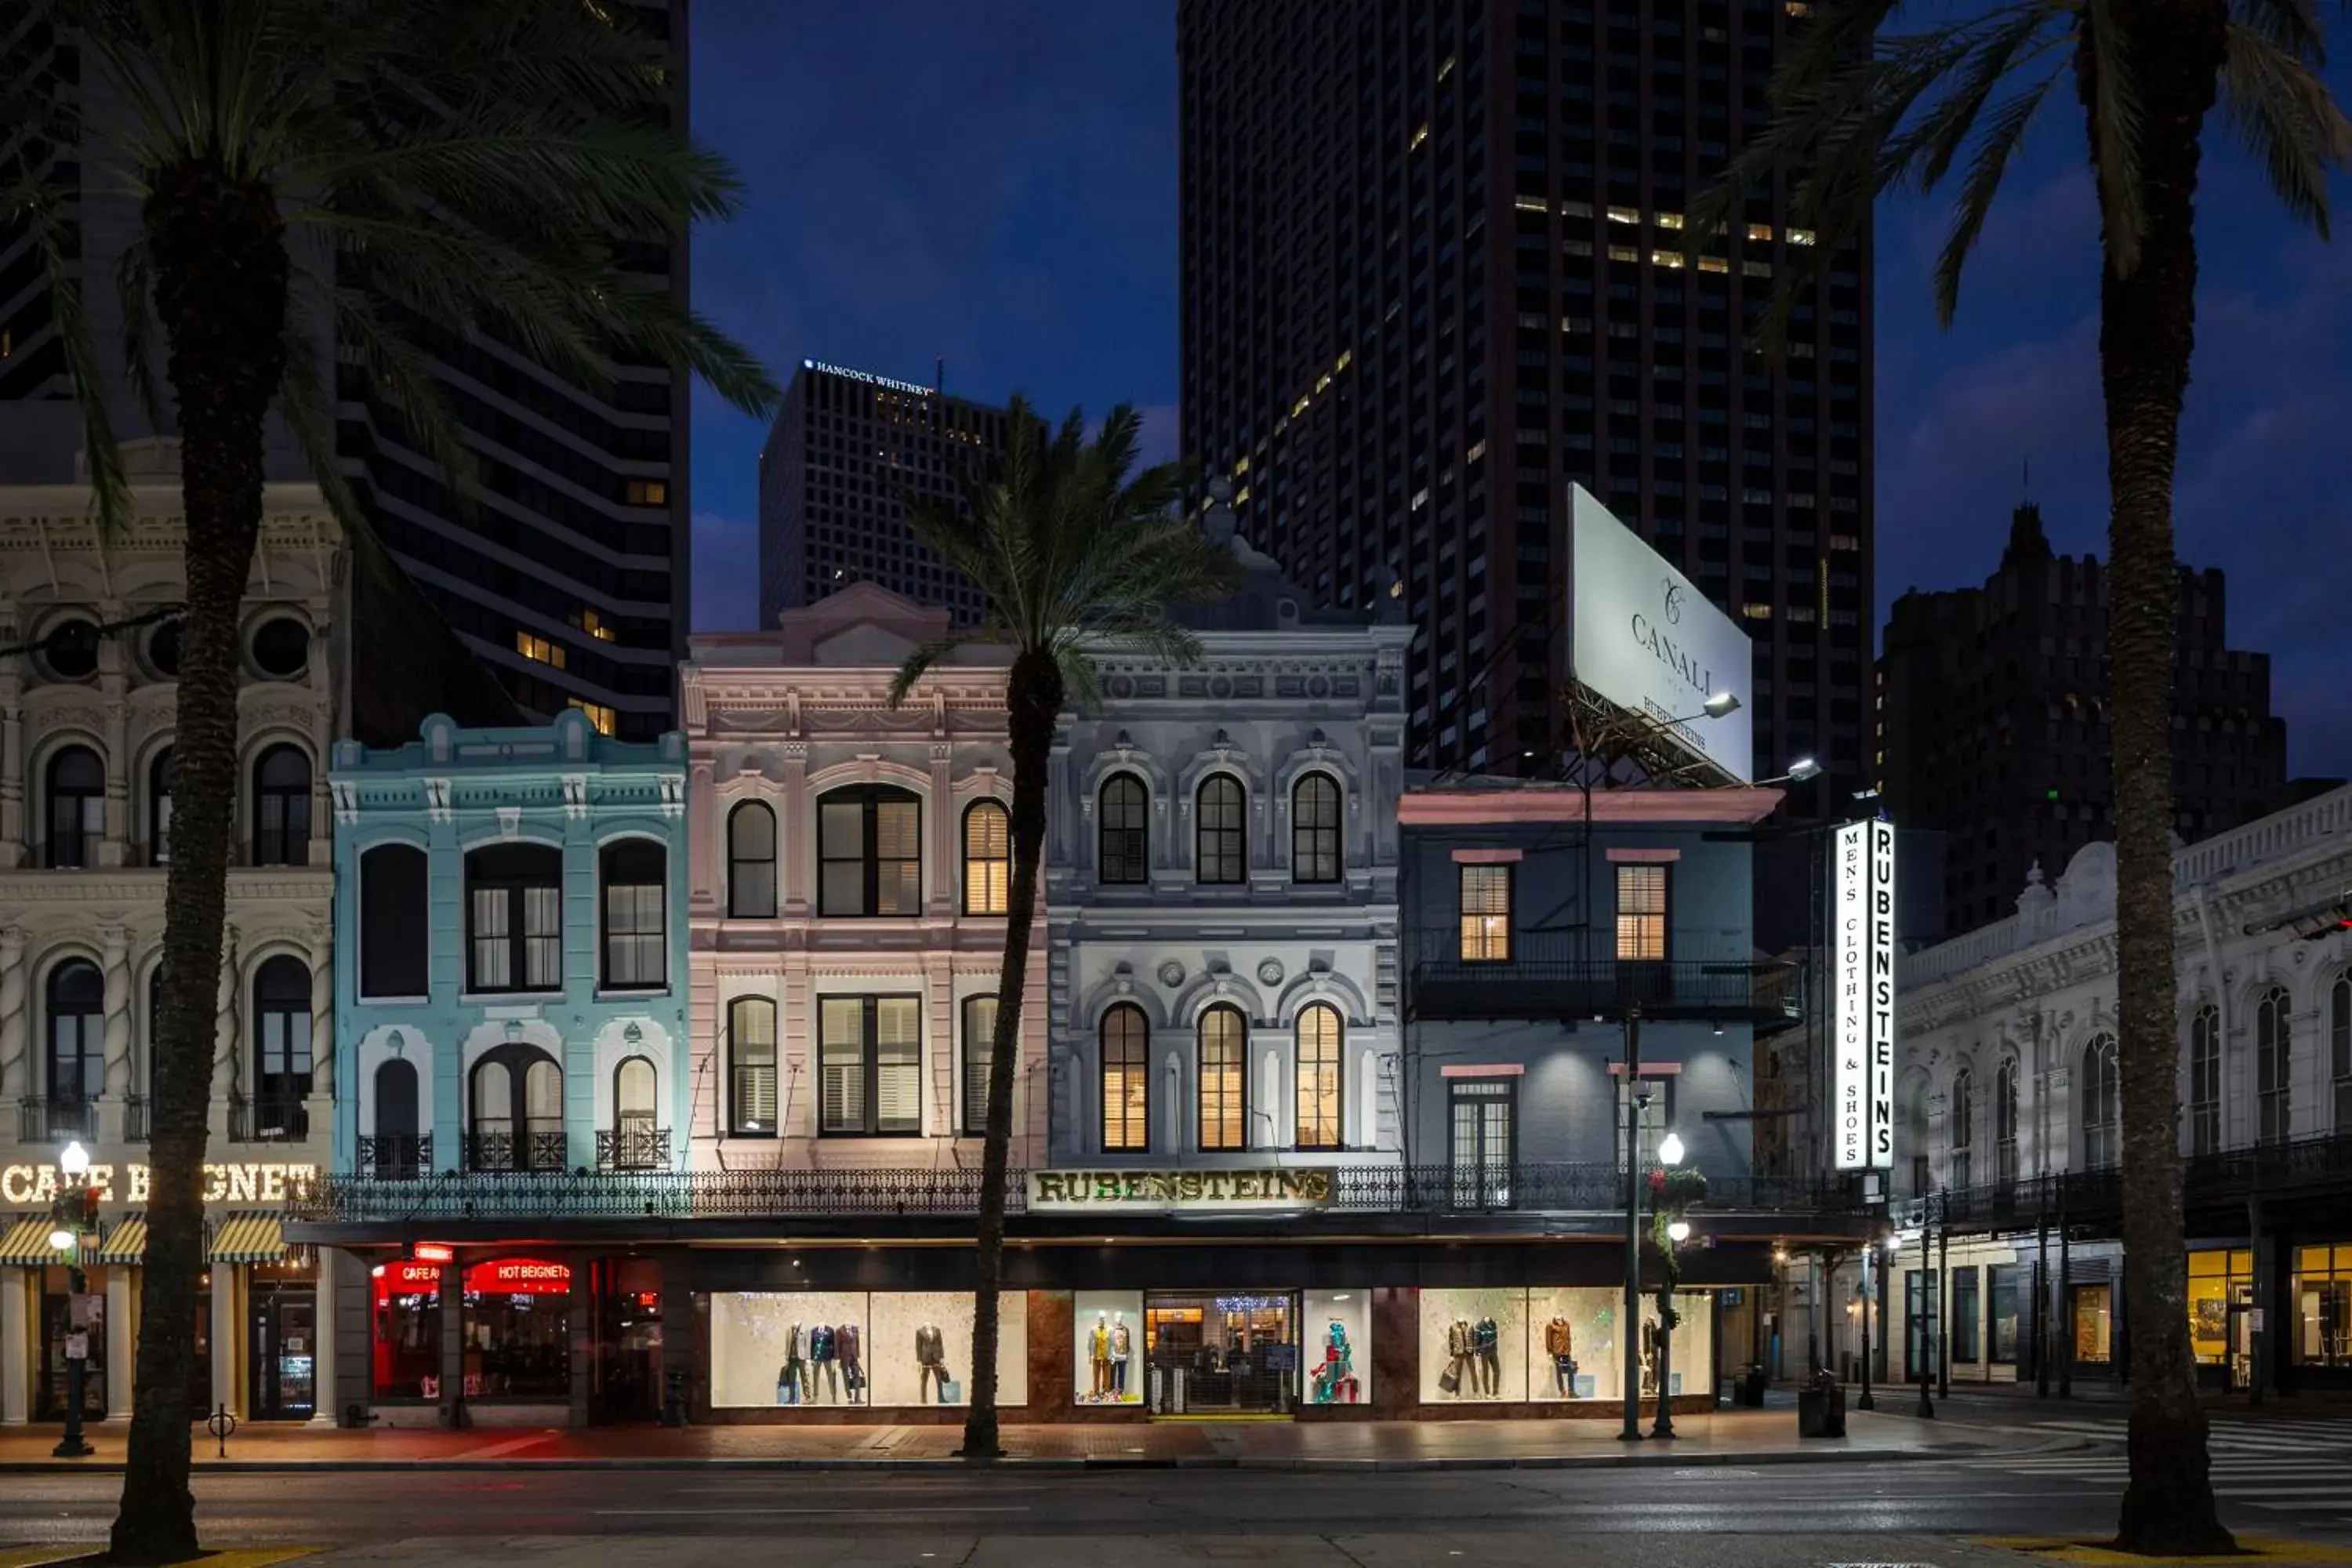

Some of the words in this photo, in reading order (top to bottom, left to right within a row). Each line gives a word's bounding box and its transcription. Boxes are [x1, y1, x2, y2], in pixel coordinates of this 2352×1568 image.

[817, 361, 874, 383] HANCOCK
[876, 376, 930, 396] WHITNEY
[1632, 614, 1711, 697] CANALI
[1846, 918, 1858, 1044] CLOTHING
[1876, 828, 1891, 1153] RUBENSTEINS
[1846, 1058, 1858, 1070] &
[1846, 1085, 1857, 1161] SHOES
[127, 1163, 315, 1202] BGNET
[402, 1267, 429, 1279] CAFE
[499, 1265, 519, 1279] HOT
